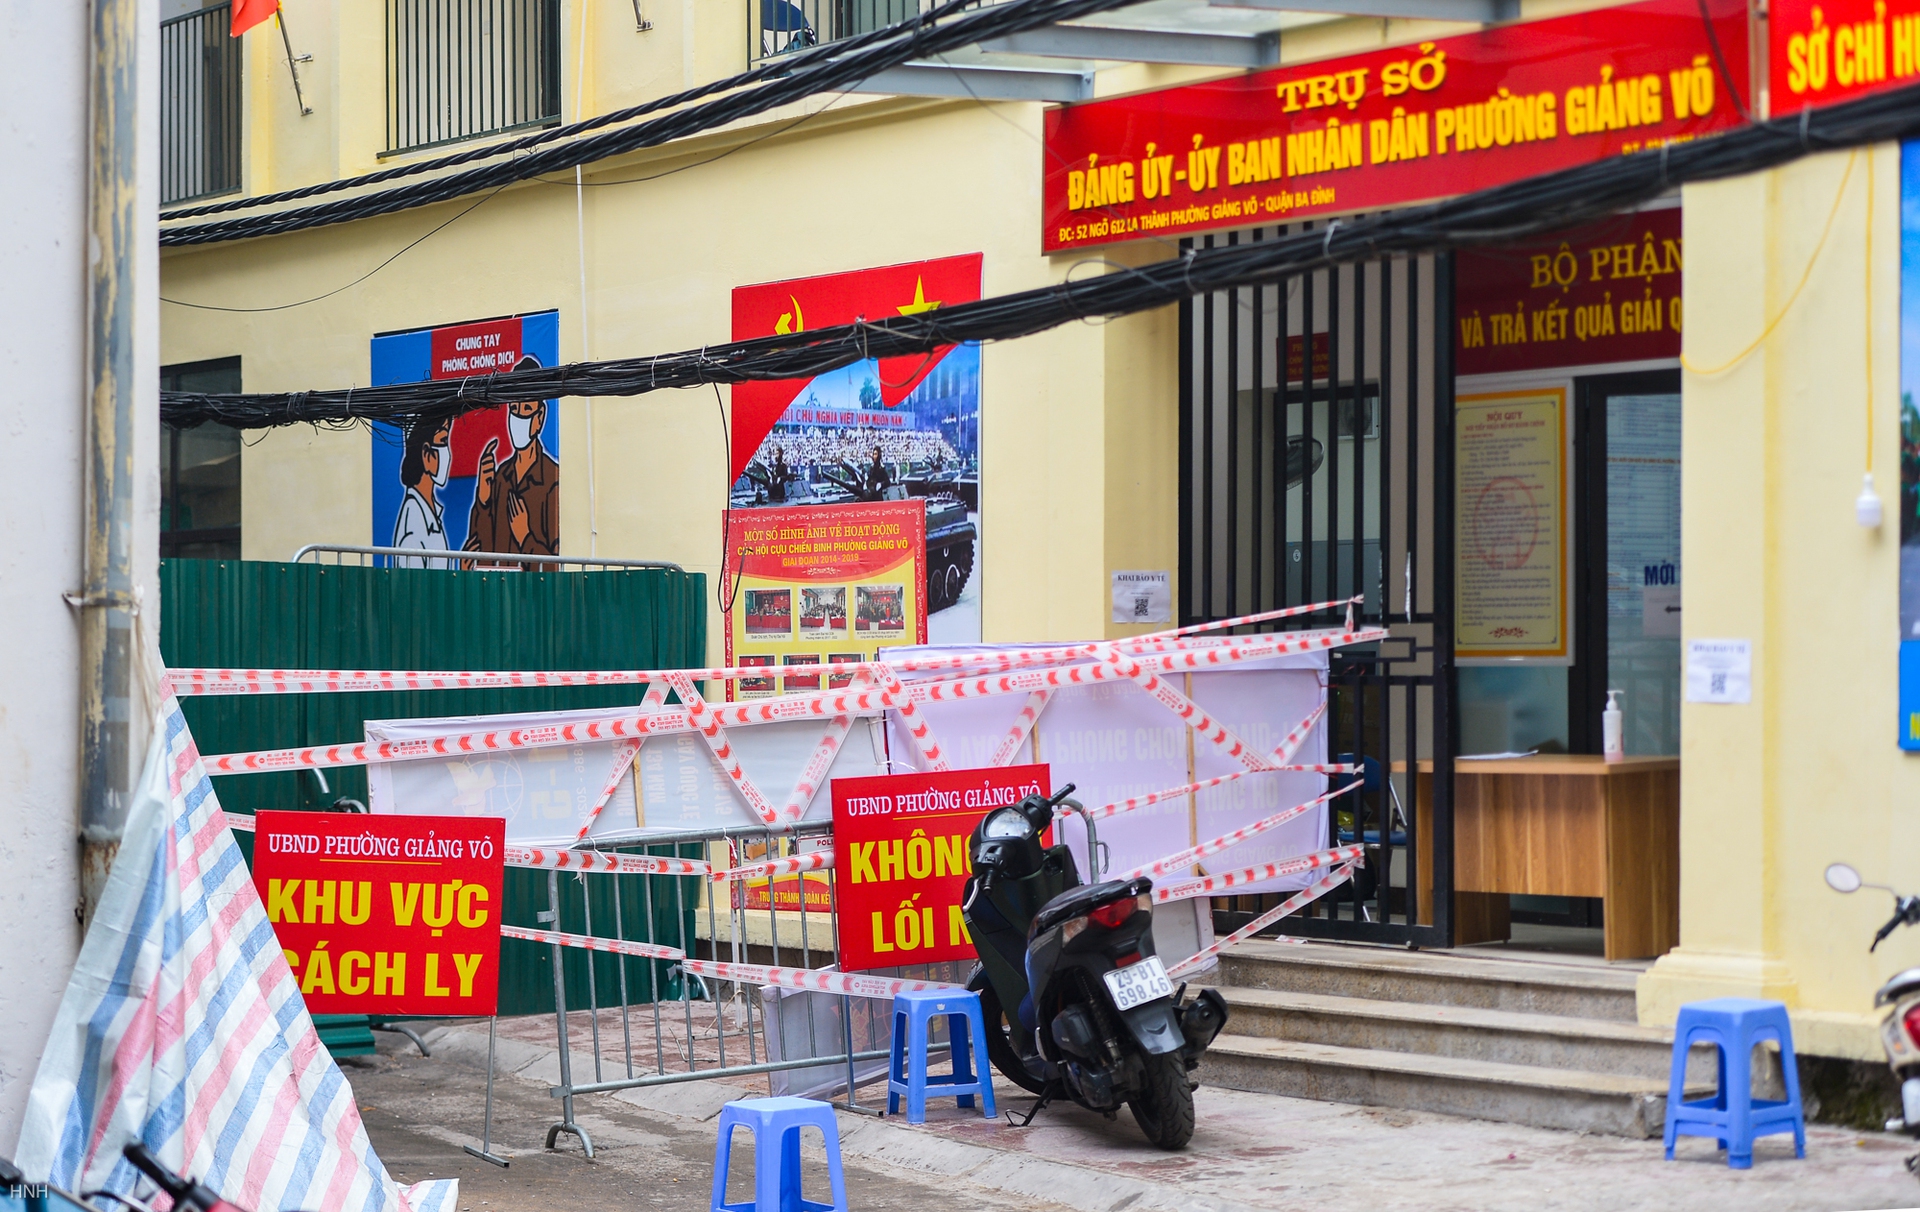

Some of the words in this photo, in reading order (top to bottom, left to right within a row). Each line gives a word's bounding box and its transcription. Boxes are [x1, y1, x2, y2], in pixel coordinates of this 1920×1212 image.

[1787, 4, 1830, 93] SỞ
[1834, 0, 1886, 87] CHỈ
[1277, 68, 1368, 113] TRỤ
[1381, 42, 1448, 97] SỞ
[1067, 153, 1135, 212] ĐẢNG
[1228, 136, 1283, 186] BAN
[1286, 117, 1363, 178] NHÂN
[1370, 106, 1430, 165] DÂN
[1436, 86, 1558, 155] PHƯỜNG
[1564, 64, 1663, 137] GIẢNG
[1669, 53, 1716, 120] VÕ
[1059, 227, 1075, 242] ĐC:
[1076, 225, 1088, 240] 52
[1089, 219, 1109, 237] NGÕ
[1110, 218, 1126, 235] 612
[1127, 217, 1139, 232] LA
[1140, 211, 1170, 231] THÀNH
[1171, 203, 1211, 227] PHƯỜNG
[1211, 197, 1241, 221] GIẢNG
[1243, 196, 1258, 216] VÕ
[1265, 190, 1293, 214] QUẬN
[1295, 192, 1309, 208] BA
[1311, 184, 1335, 205] ĐÌNH
[1530, 242, 1578, 293] BỘ
[1589, 231, 1682, 282] PHẬN
[1461, 310, 1485, 348] VÀ
[1490, 301, 1527, 345] TRẢ
[1532, 299, 1569, 342] KẾT
[1574, 291, 1615, 341] QUẢ
[1620, 288, 1663, 335] GIẢI
[456, 336, 482, 351] CHUNG
[483, 333, 501, 347] TAY
[442, 356, 470, 372] PHÒNG,
[470, 350, 496, 369] CHỐNG
[497, 351, 515, 367] DỊCH
[744, 528, 764, 542] MỘT
[766, 524, 778, 541] SỐ
[780, 525, 805, 540] HÌNH
[806, 523, 827, 538] ẢNH
[829, 521, 841, 537] VỀ
[844, 523, 870, 538] HOẠT
[872, 521, 900, 536] ĐỘNG
[755, 543, 769, 556] HỘI
[770, 542, 788, 555] CỰU
[789, 540, 812, 554] CHIẾN
[814, 542, 832, 553] BINH
[833, 537, 868, 551] PHƯỜNG
[869, 537, 895, 550] GIẢNG
[896, 537, 908, 549] VÕ
[782, 556, 797, 567] GIAI
[841, 553, 859, 563] 2019
[1117, 574, 1135, 582] KHAI
[1136, 573, 1150, 582] BÁO
[847, 796, 892, 816] UBND
[896, 786, 961, 813] PHƯỜNG
[964, 780, 1016, 807] GIẢNG
[268, 834, 320, 854] UBND
[324, 831, 400, 857] PHƯỜNG
[404, 830, 463, 859] GIẢNG
[468, 836, 494, 860] VÕ
[850, 829, 972, 884] KHÔN
[267, 878, 372, 926] KHU
[390, 879, 489, 937] VỰC
[759, 891, 778, 903] TRUG
[780, 890, 799, 904] THÀNH
[872, 892, 934, 953] LỐI
[424, 953, 483, 997] LY
[1113, 962, 1156, 989] 29-B1
[1117, 976, 1169, 1007] 698.46
